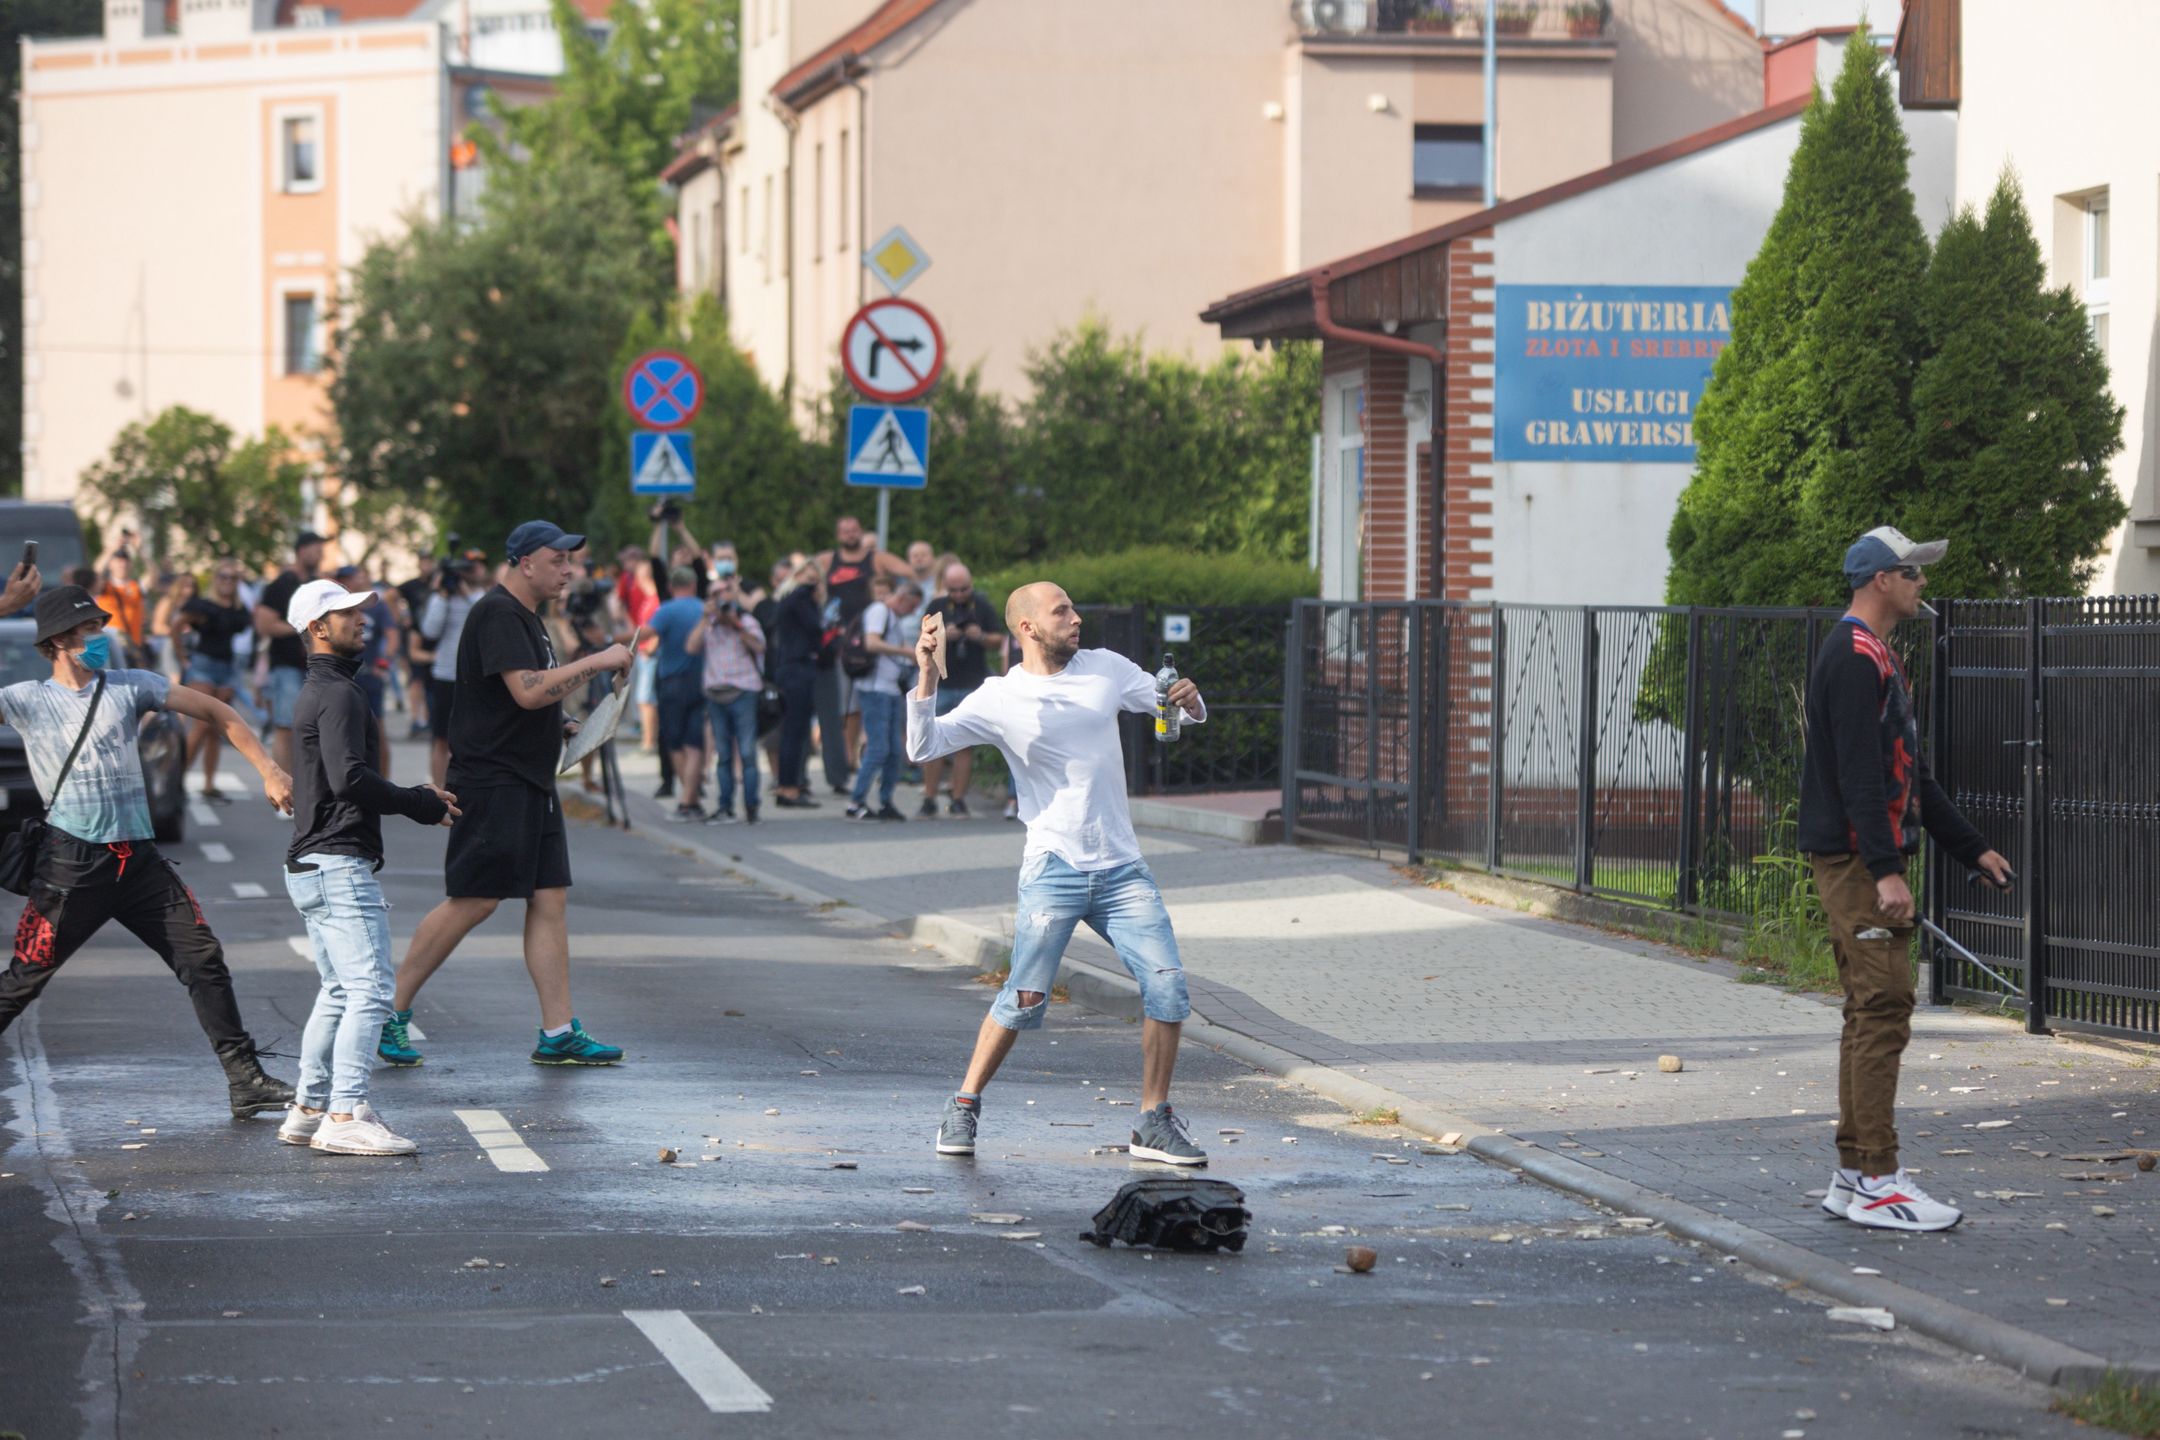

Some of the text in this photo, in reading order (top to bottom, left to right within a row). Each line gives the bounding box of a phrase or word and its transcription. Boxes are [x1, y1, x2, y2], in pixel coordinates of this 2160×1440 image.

[1526, 292, 1730, 332] BIŻUTERIA
[1611, 339, 1619, 357] I
[1572, 389, 1690, 415] USŁUGI
